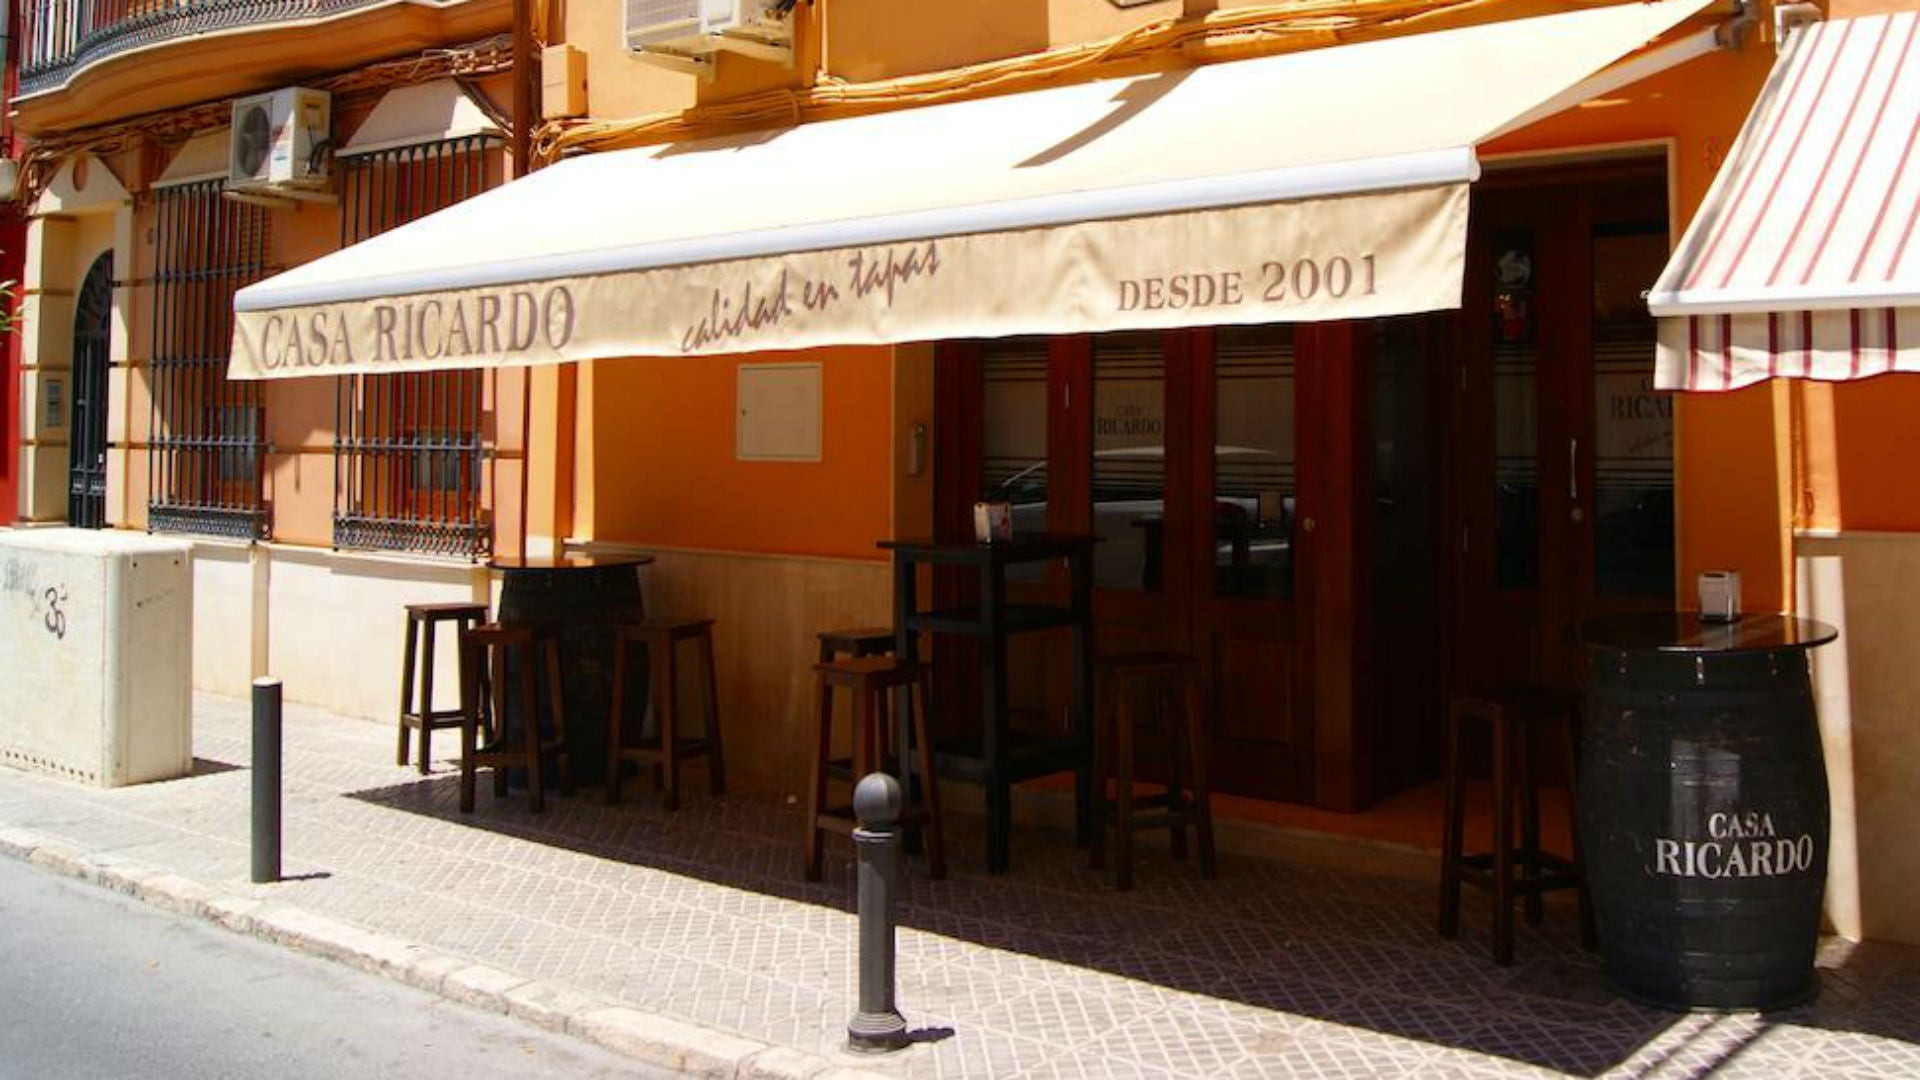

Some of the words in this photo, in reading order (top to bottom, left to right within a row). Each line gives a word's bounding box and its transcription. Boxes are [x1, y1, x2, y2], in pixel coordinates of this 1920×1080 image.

[681, 268, 792, 352] calidad
[803, 280, 839, 311] en
[848, 238, 940, 308] tapas
[1117, 271, 1243, 312] DESDE
[1261, 254, 1379, 303] 2001
[262, 310, 354, 370] CASA
[373, 286, 575, 362] RICARDO
[1708, 812, 1776, 839] CASA
[1655, 834, 1814, 879] RICARDO
